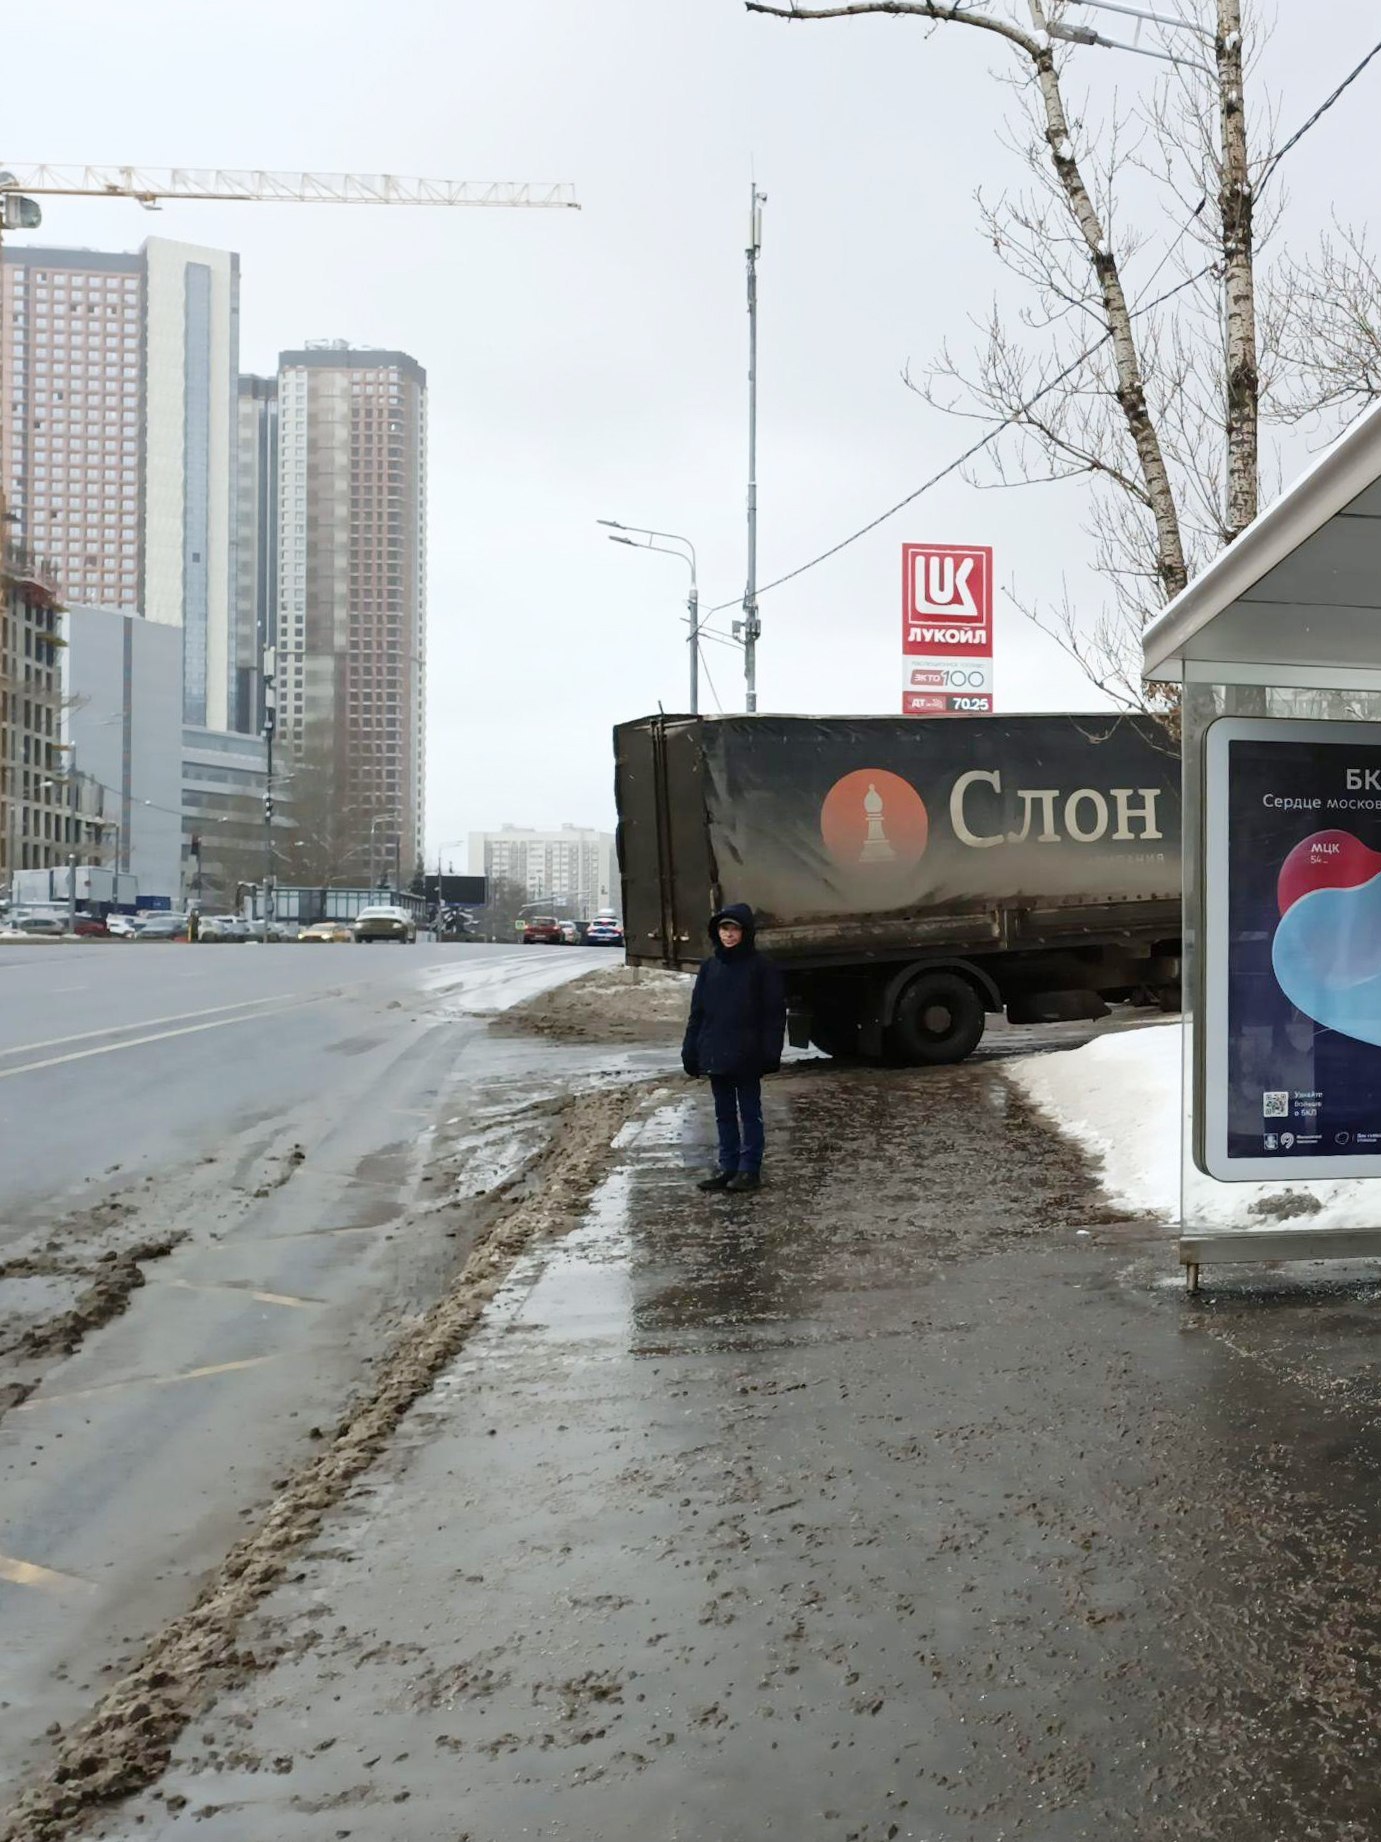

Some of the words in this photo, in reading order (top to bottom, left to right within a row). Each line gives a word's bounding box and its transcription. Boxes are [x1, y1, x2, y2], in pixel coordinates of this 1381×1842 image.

[907, 626, 988, 645] ЛУКОЙЛ
[911, 698, 926, 709] ДТ
[949, 769, 1163, 848] Слон
[1262, 793, 1322, 811] Сердце
[1311, 843, 1340, 854] МЦК
